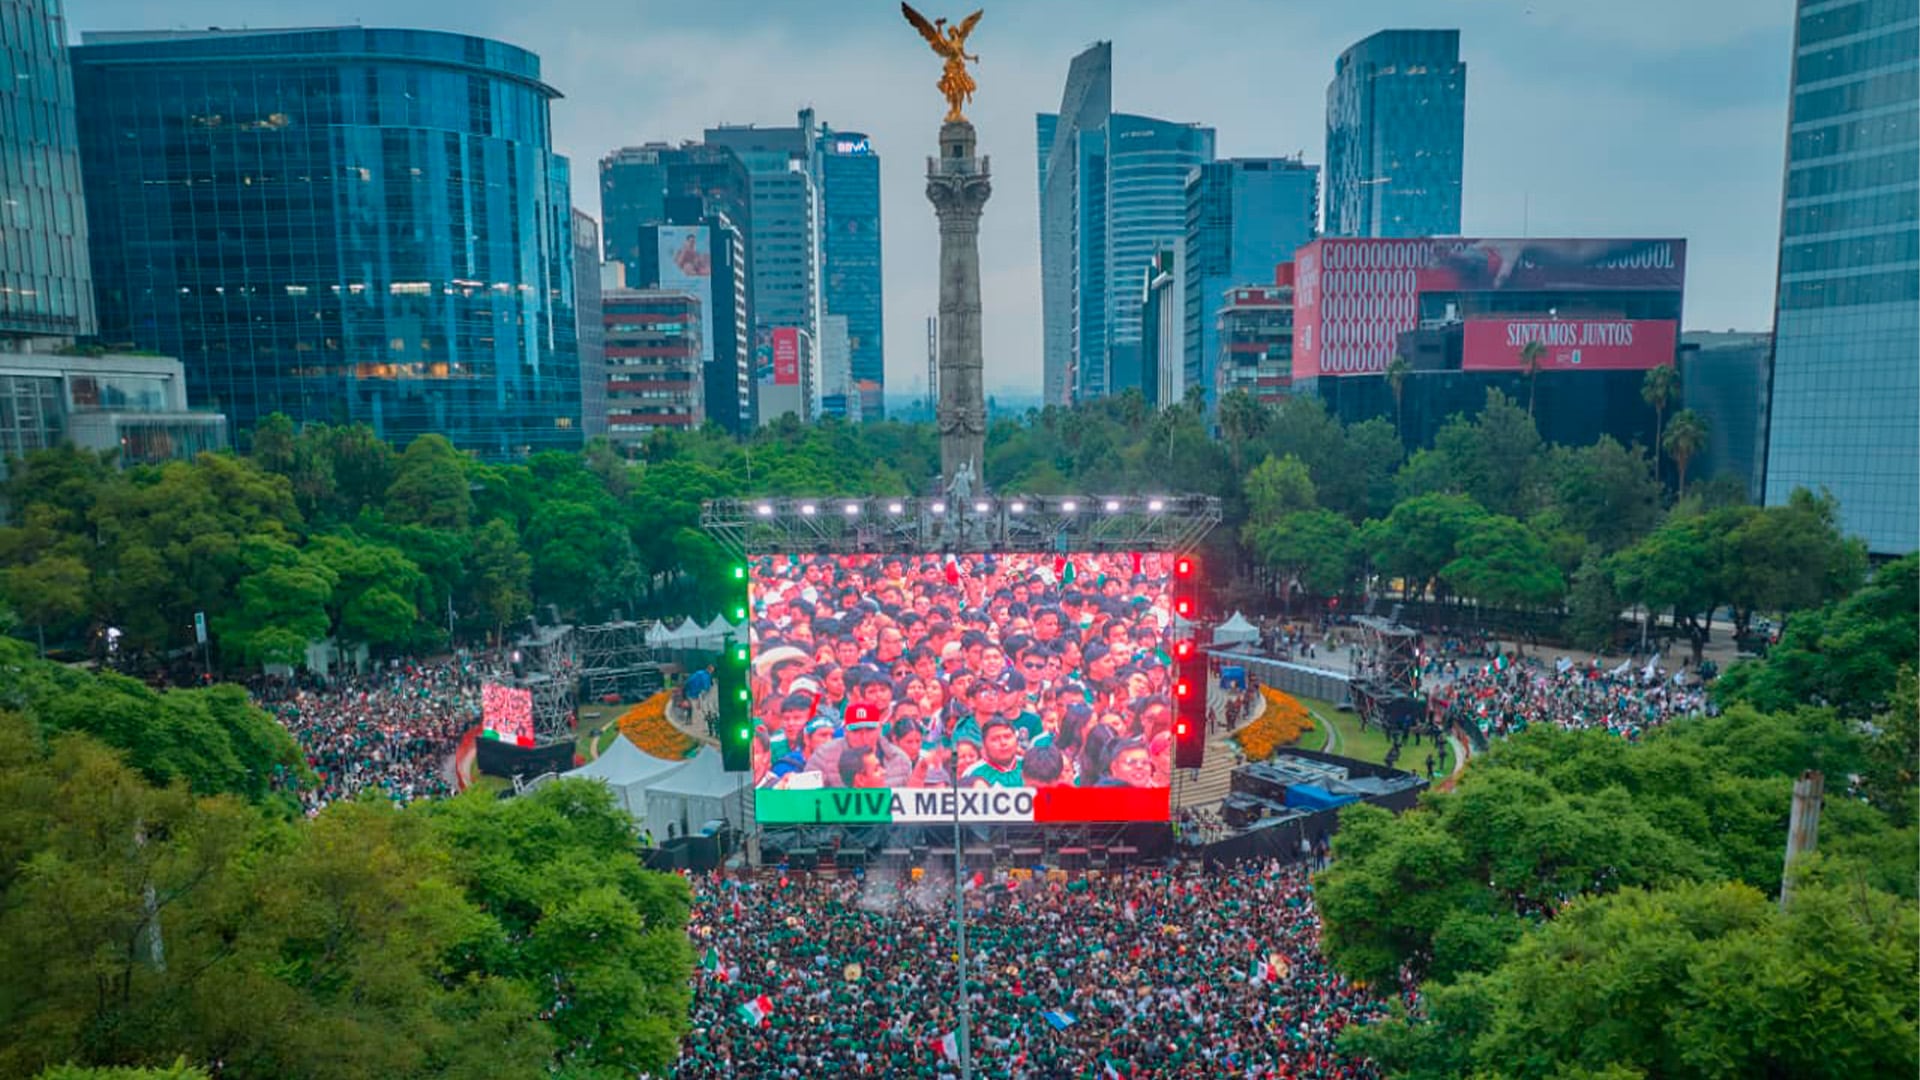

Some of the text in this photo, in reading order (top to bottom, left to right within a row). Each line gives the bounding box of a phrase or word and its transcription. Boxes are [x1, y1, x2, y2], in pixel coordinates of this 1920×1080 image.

[1507, 322, 1633, 347] SINTAMOS JUNTOS
[832, 792, 906, 816] VIVA
[915, 792, 1033, 816] MEXICO
